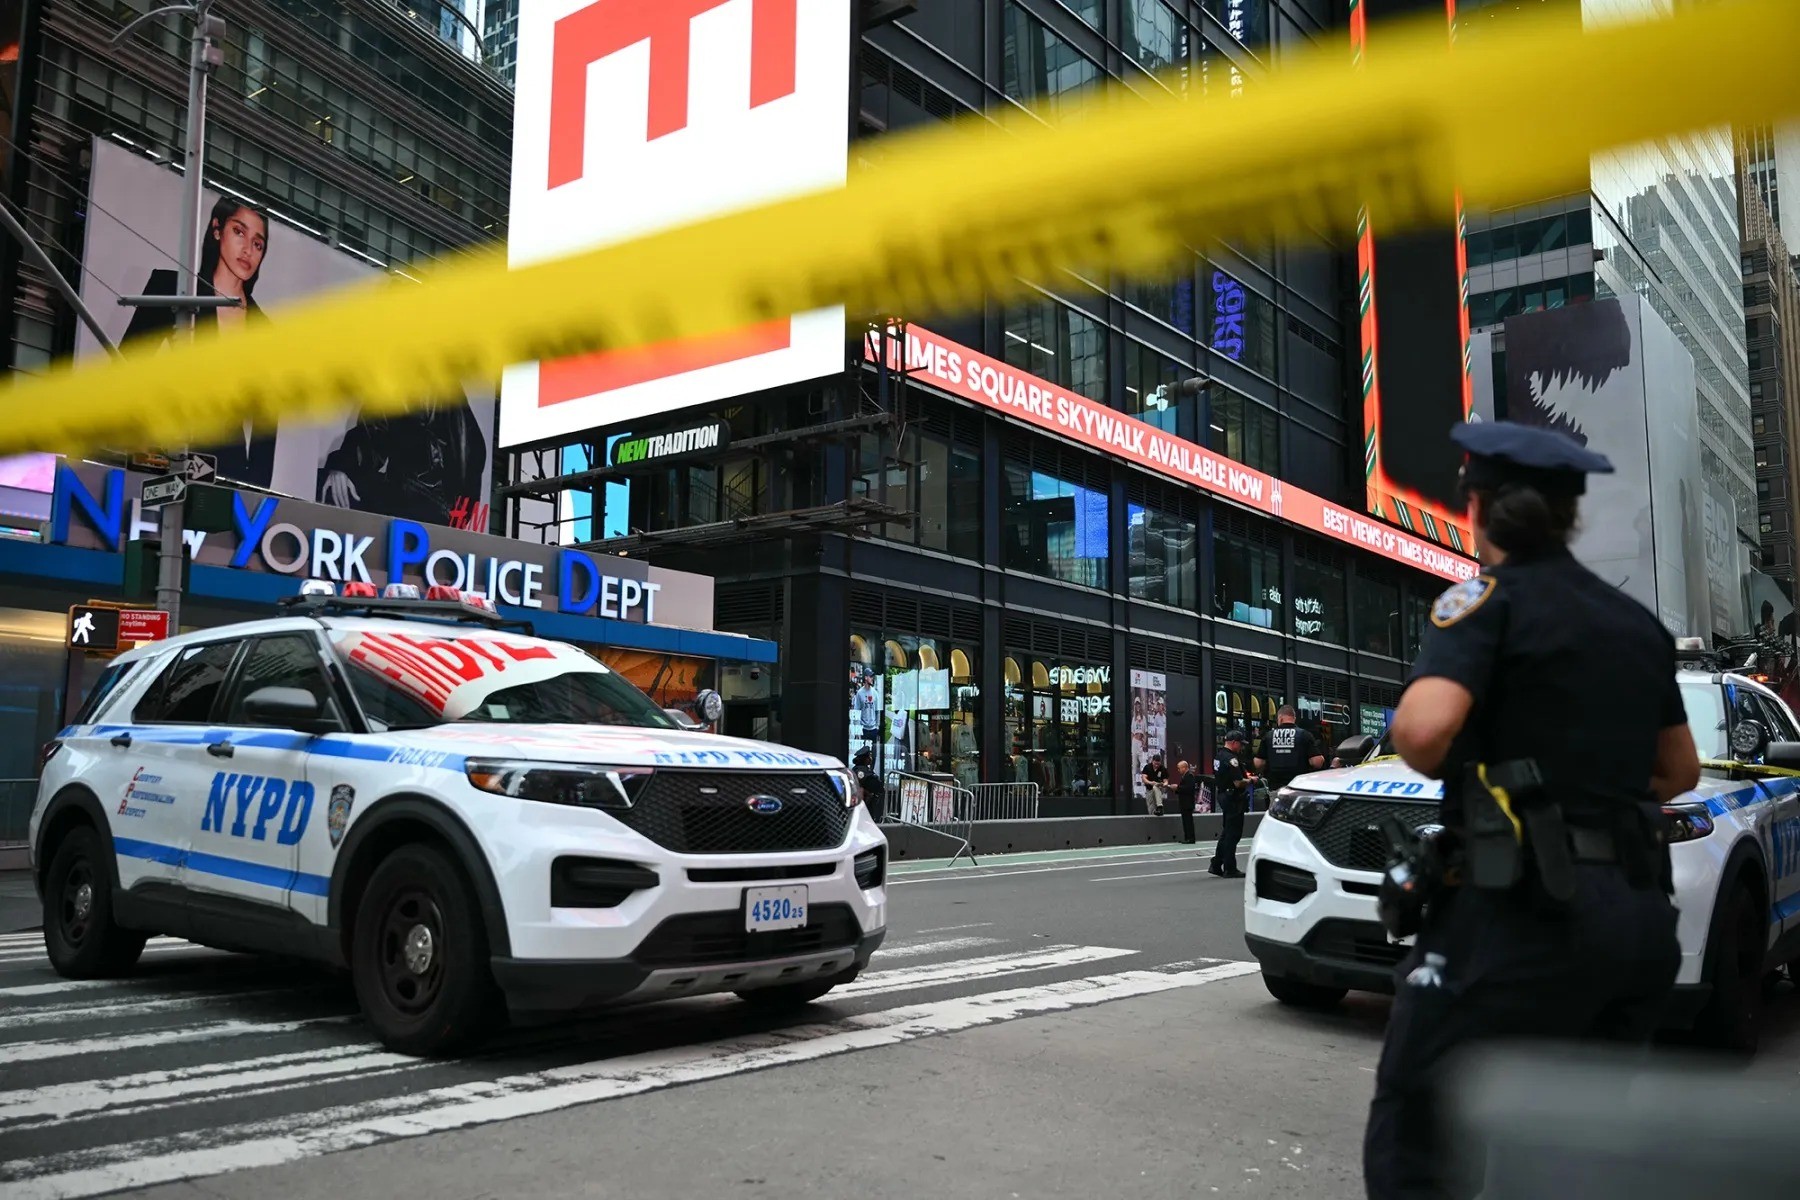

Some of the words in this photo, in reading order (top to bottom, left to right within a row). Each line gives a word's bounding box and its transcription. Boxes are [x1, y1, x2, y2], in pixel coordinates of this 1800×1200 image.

[966, 360, 1053, 421] SQUARE
[1056, 396, 1145, 456] SKYWALK
[1147, 435, 1227, 488] AVAILABLE
[1228, 467, 1263, 502] NOW
[145, 486, 158, 499] ONE
[165, 482, 180, 495] WAY
[1323, 506, 1349, 536] BEST
[1349, 516, 1382, 549] VIEWS
[1382, 531, 1395, 553] OF
[1396, 536, 1423, 564] TIMES
[1422, 547, 1455, 576] SQUARE
[229, 491, 375, 584] YORK
[387, 518, 544, 608] POLICE
[558, 549, 661, 623] DEPT
[1272, 728, 1296, 738] NYPD
[1272, 737, 1295, 746] POLICE
[388, 747, 445, 768] POLICE
[654, 750, 730, 765] NYPD
[734, 750, 820, 767] POLICE
[1346, 779, 1424, 796] NYPD
[200, 771, 316, 846] NYPD
[752, 898, 790, 922] 4520
[791, 906, 804, 919] 25
